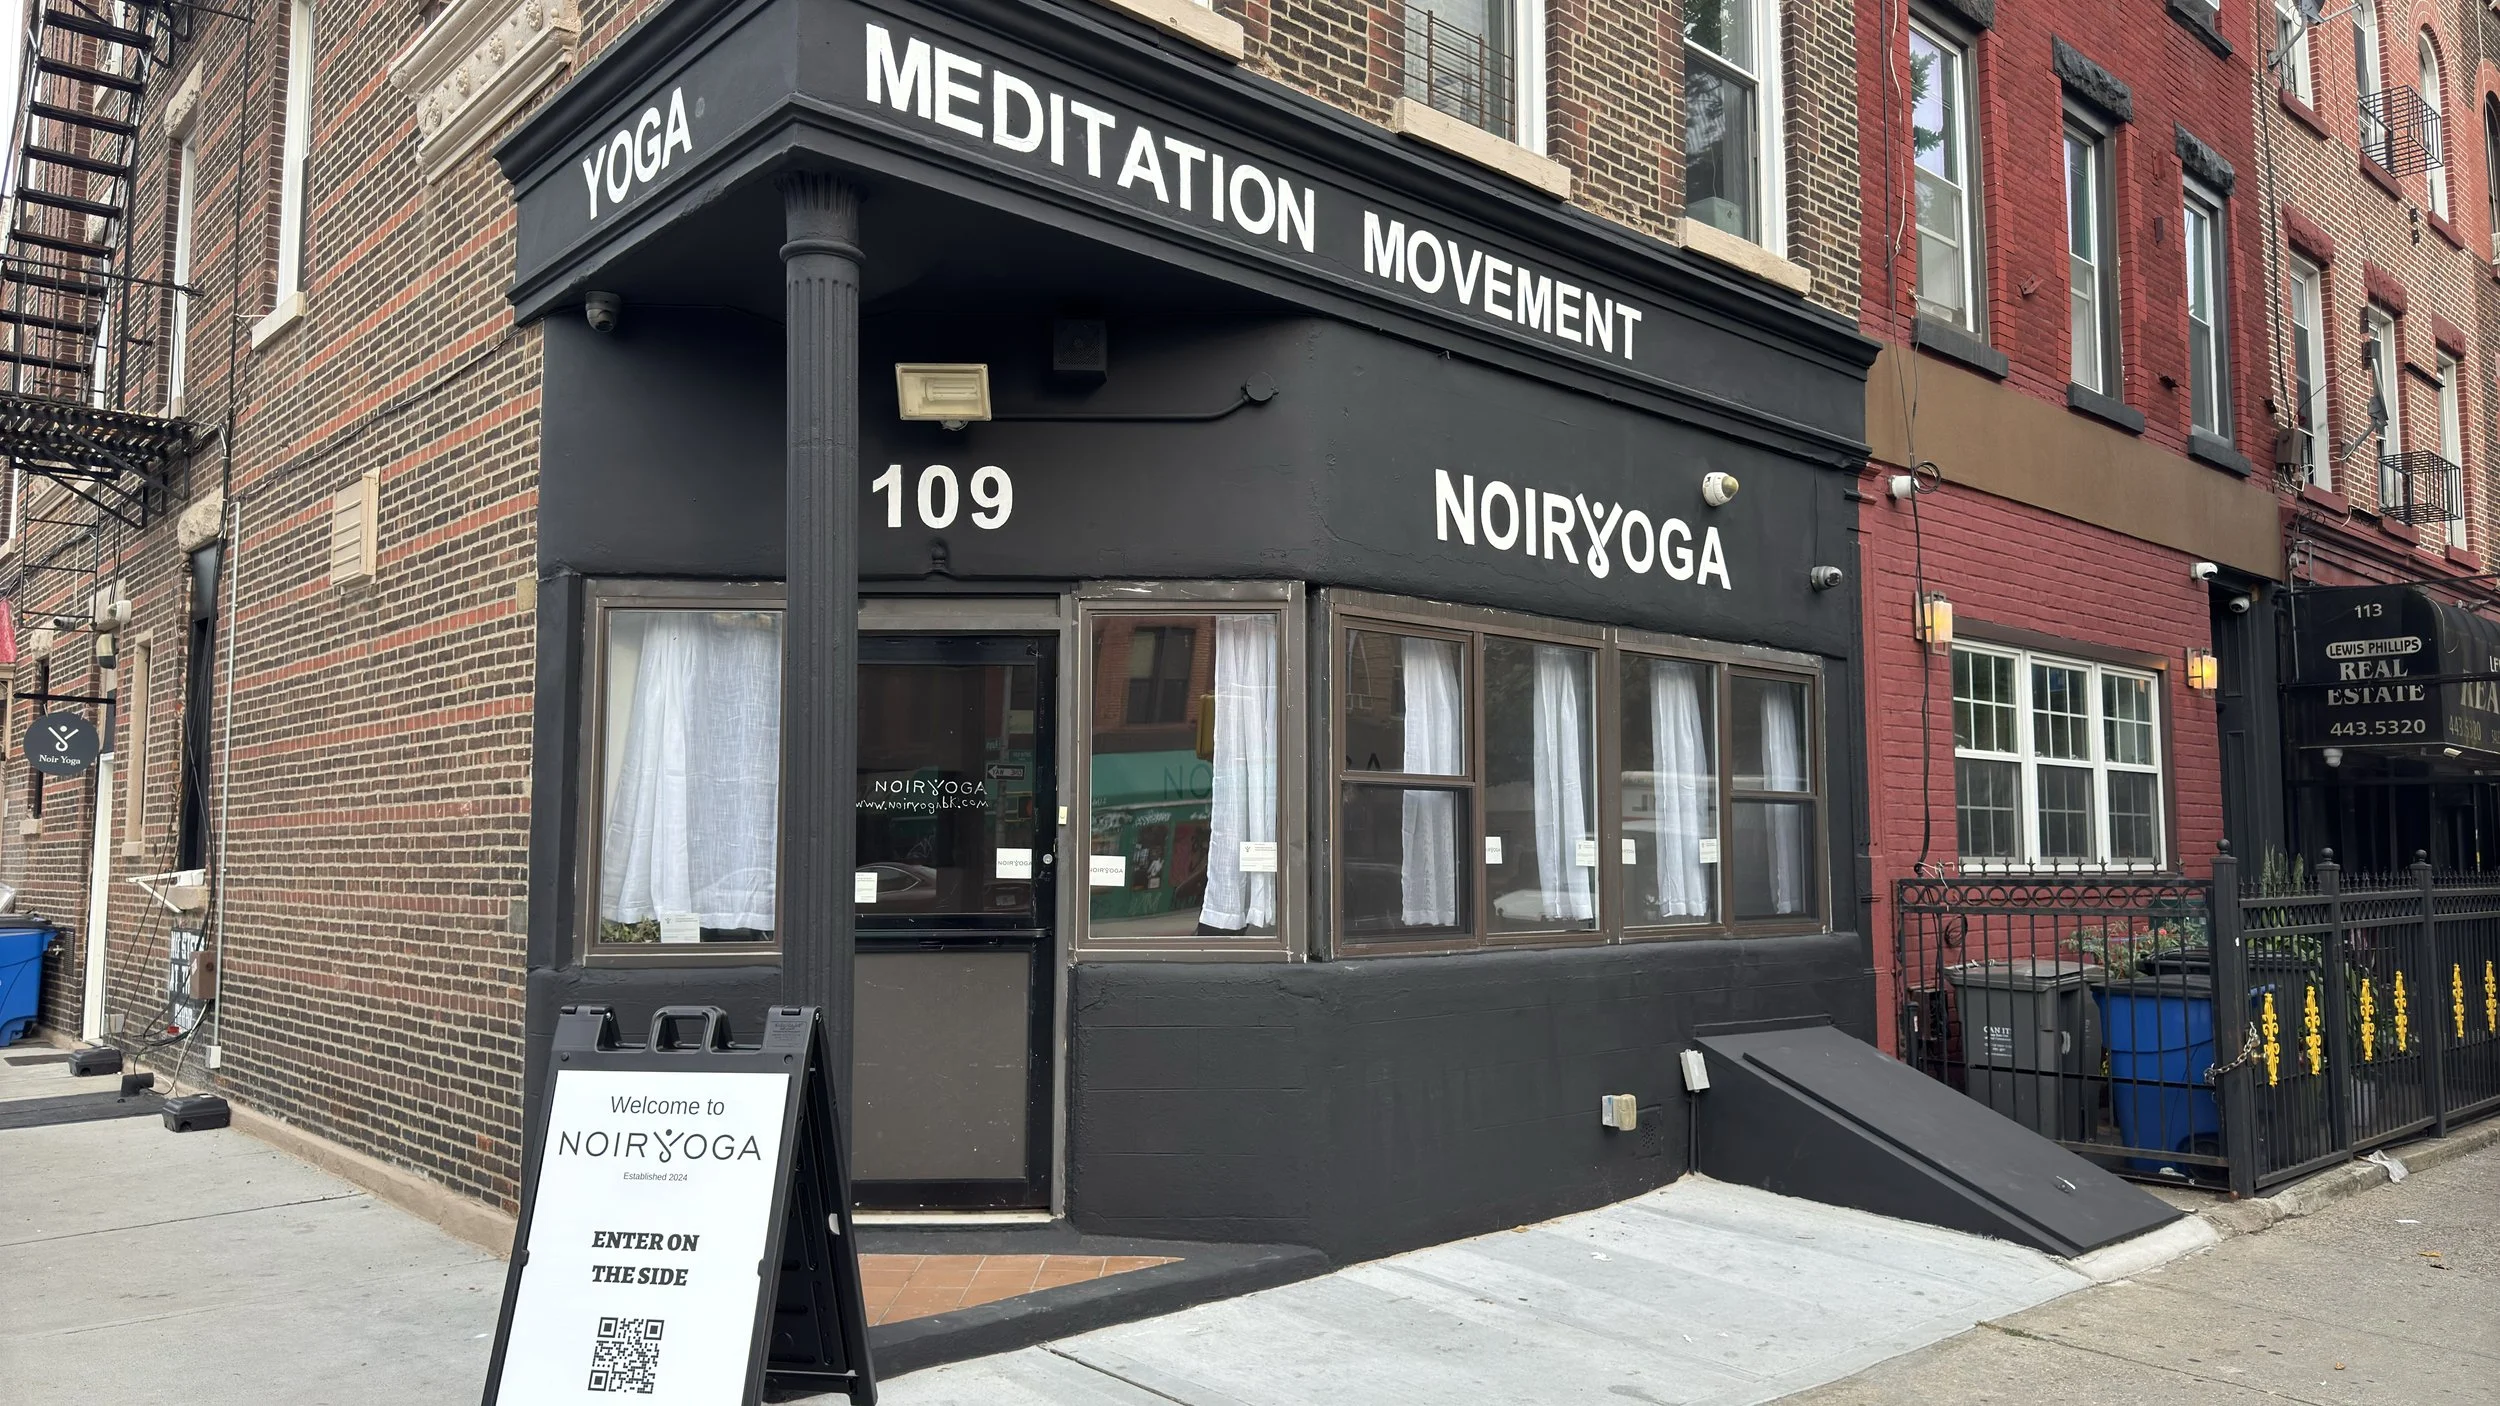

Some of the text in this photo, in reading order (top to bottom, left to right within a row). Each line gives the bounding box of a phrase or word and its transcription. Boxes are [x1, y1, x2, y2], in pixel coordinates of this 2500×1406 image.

[583, 87, 692, 220] YOGA
[865, 22, 1642, 360] MEDITATION MOVEMENT
[872, 464, 1014, 530] 109
[2354, 603, 2383, 619] 113
[2329, 639, 2419, 657] LEWIS PHILLIPS
[2339, 659, 2408, 681] REAL
[2327, 684, 2426, 706] ESTATE
[2330, 719, 2427, 737] 443.5320
[39, 754, 81, 766] Noir Yoga
[610, 1095, 725, 1116] Welcome to
[623, 1171, 688, 1182] Established 2024
[592, 1230, 700, 1252] ENTER ON
[591, 1265, 689, 1287] THE SIDE
